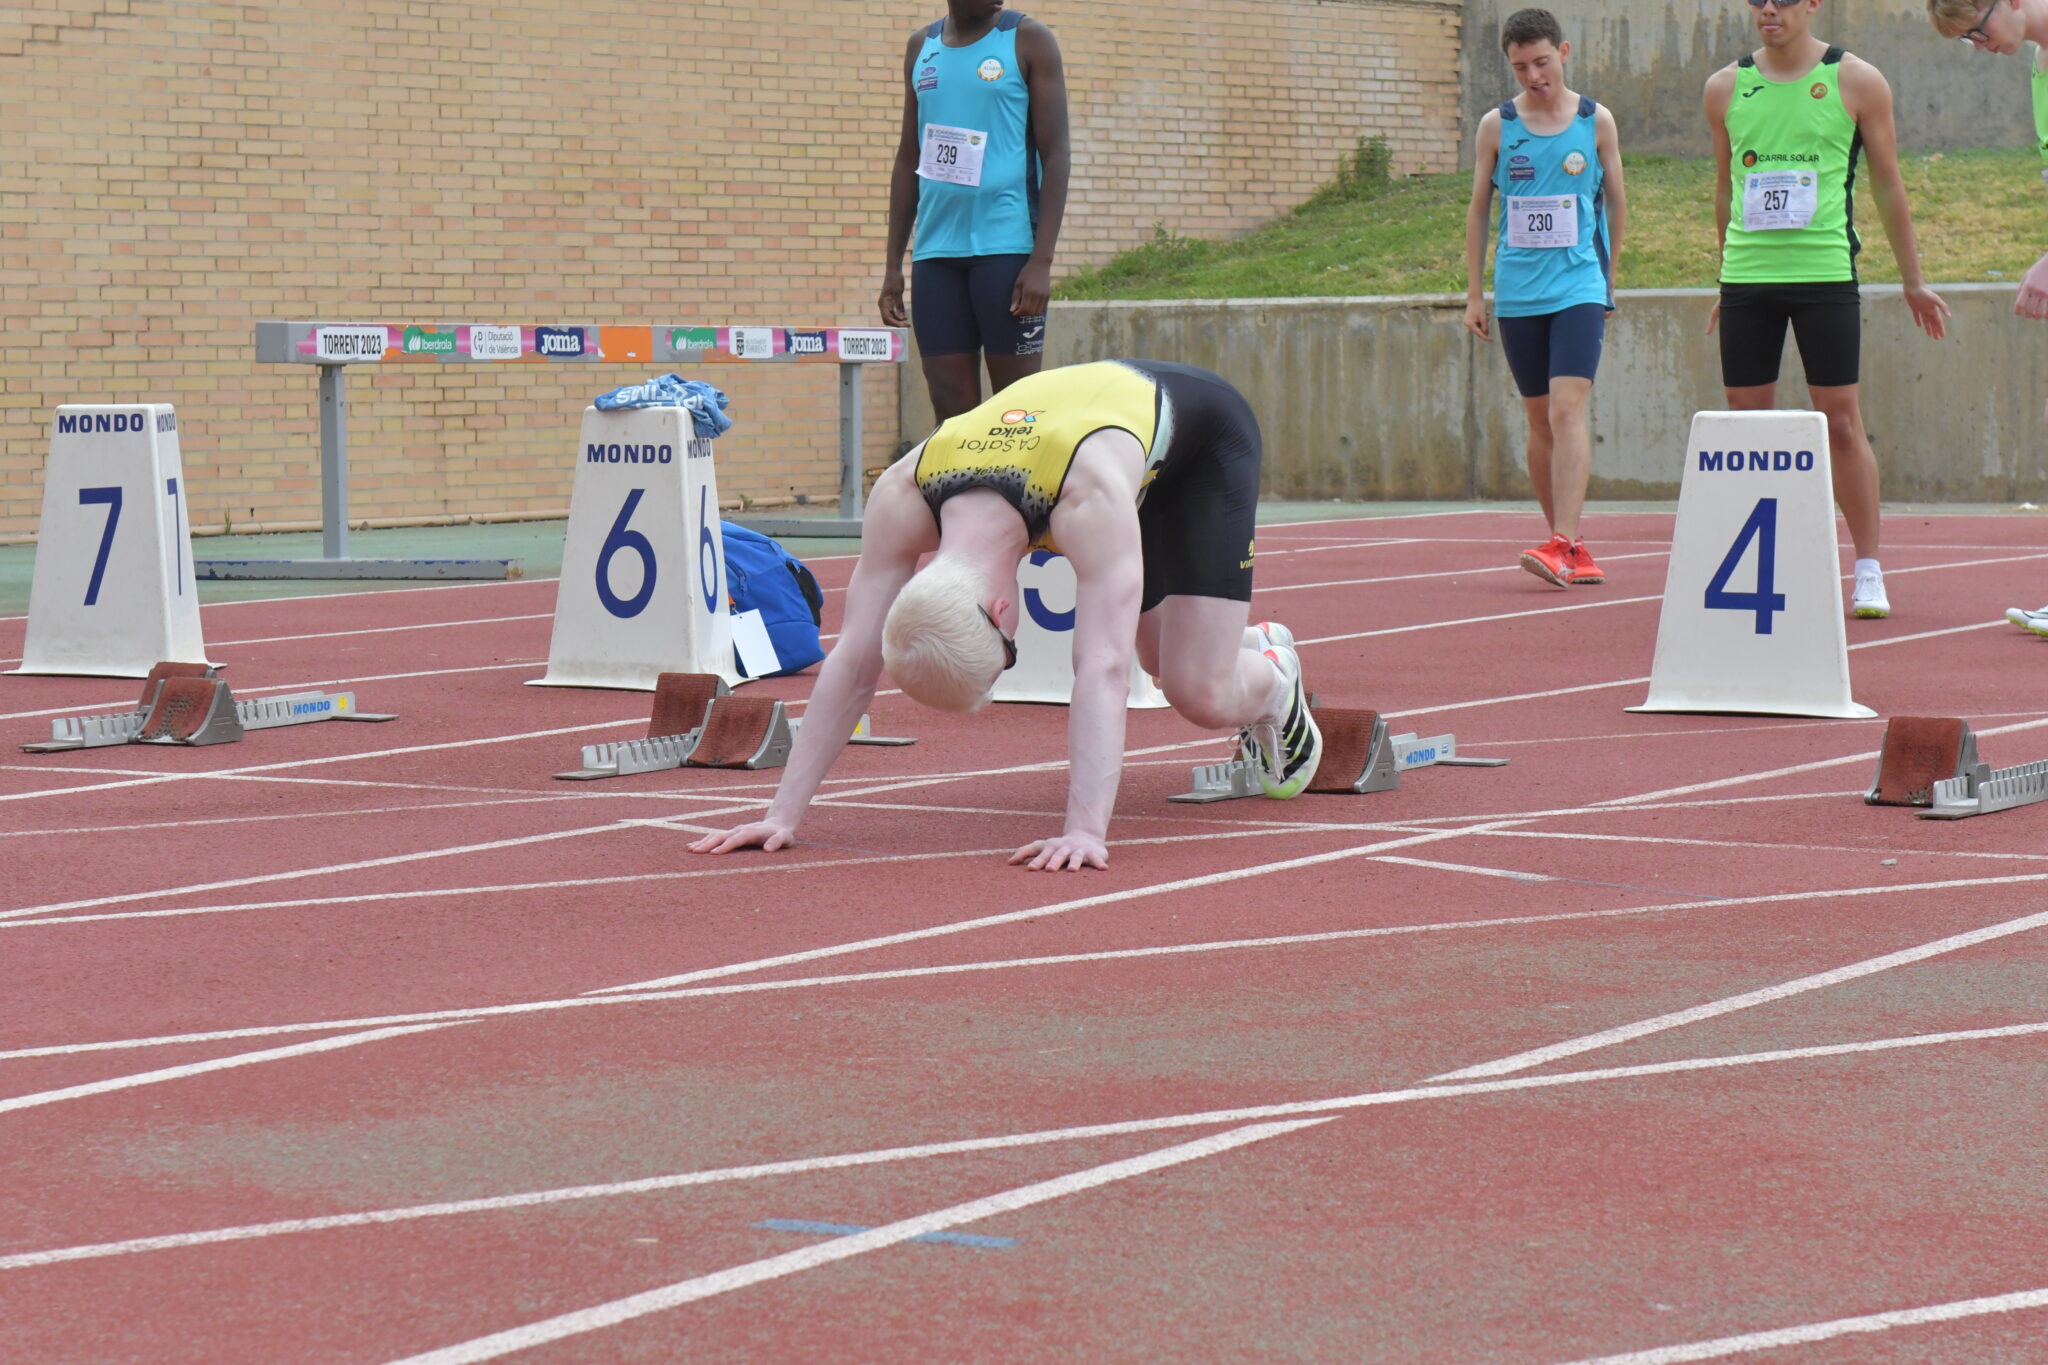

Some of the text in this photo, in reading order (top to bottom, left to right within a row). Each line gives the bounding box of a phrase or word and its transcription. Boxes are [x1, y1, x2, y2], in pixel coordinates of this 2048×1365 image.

[936, 143, 958, 165] 239
[1758, 154, 1820, 162] CARRIL SOLAR
[1763, 190, 1789, 211] 257
[1528, 213, 1552, 232] 230
[323, 334, 382, 355] TORRENT 2023
[421, 338, 453, 351] Iberdrola
[488, 332, 513, 342] Diputació
[843, 337, 887, 355] TORRENT 2023
[58, 413, 144, 433] MONDO
[156, 413, 177, 433] MONDO
[988, 426, 1034, 436] teika
[587, 443, 672, 464] MONDO
[687, 438, 711, 459] MONDO
[957, 435, 1041, 454] CA Safor
[1699, 450, 1814, 472] MONDO
[79, 486, 123, 606] 7
[595, 488, 657, 619] 6
[699, 484, 718, 614] 6
[1704, 498, 1786, 635] 4
[293, 700, 331, 715] MONDO
